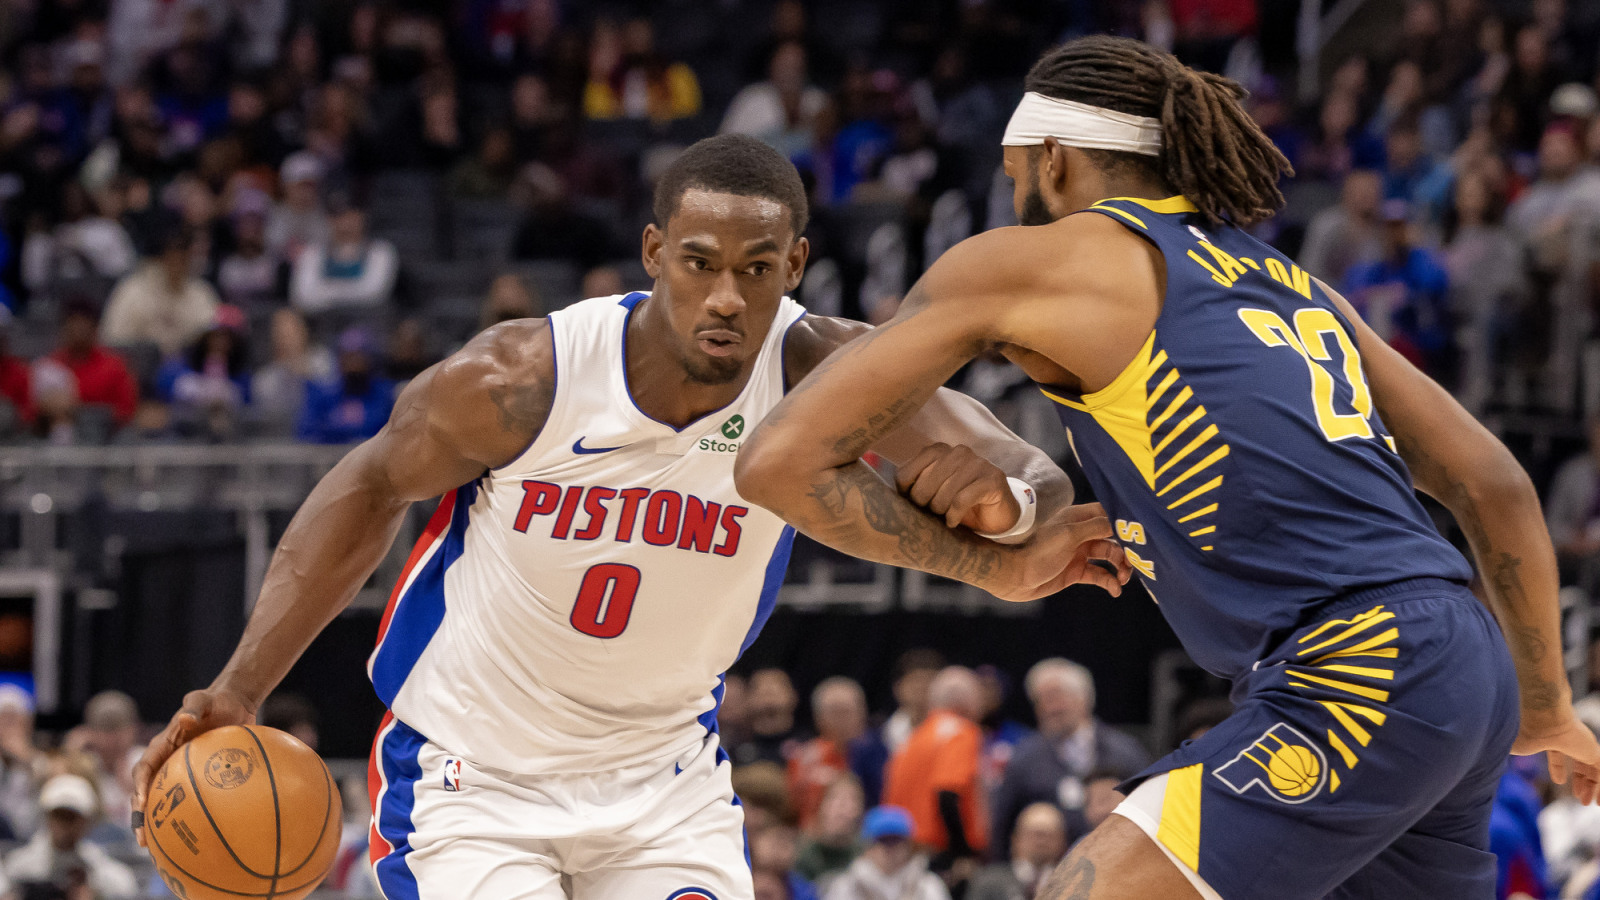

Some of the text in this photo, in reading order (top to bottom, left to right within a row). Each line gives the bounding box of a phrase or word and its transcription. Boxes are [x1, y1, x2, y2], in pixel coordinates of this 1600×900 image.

[1237, 307, 1397, 454] 22
[513, 480, 749, 558] PISTONS
[569, 562, 642, 639] 0
